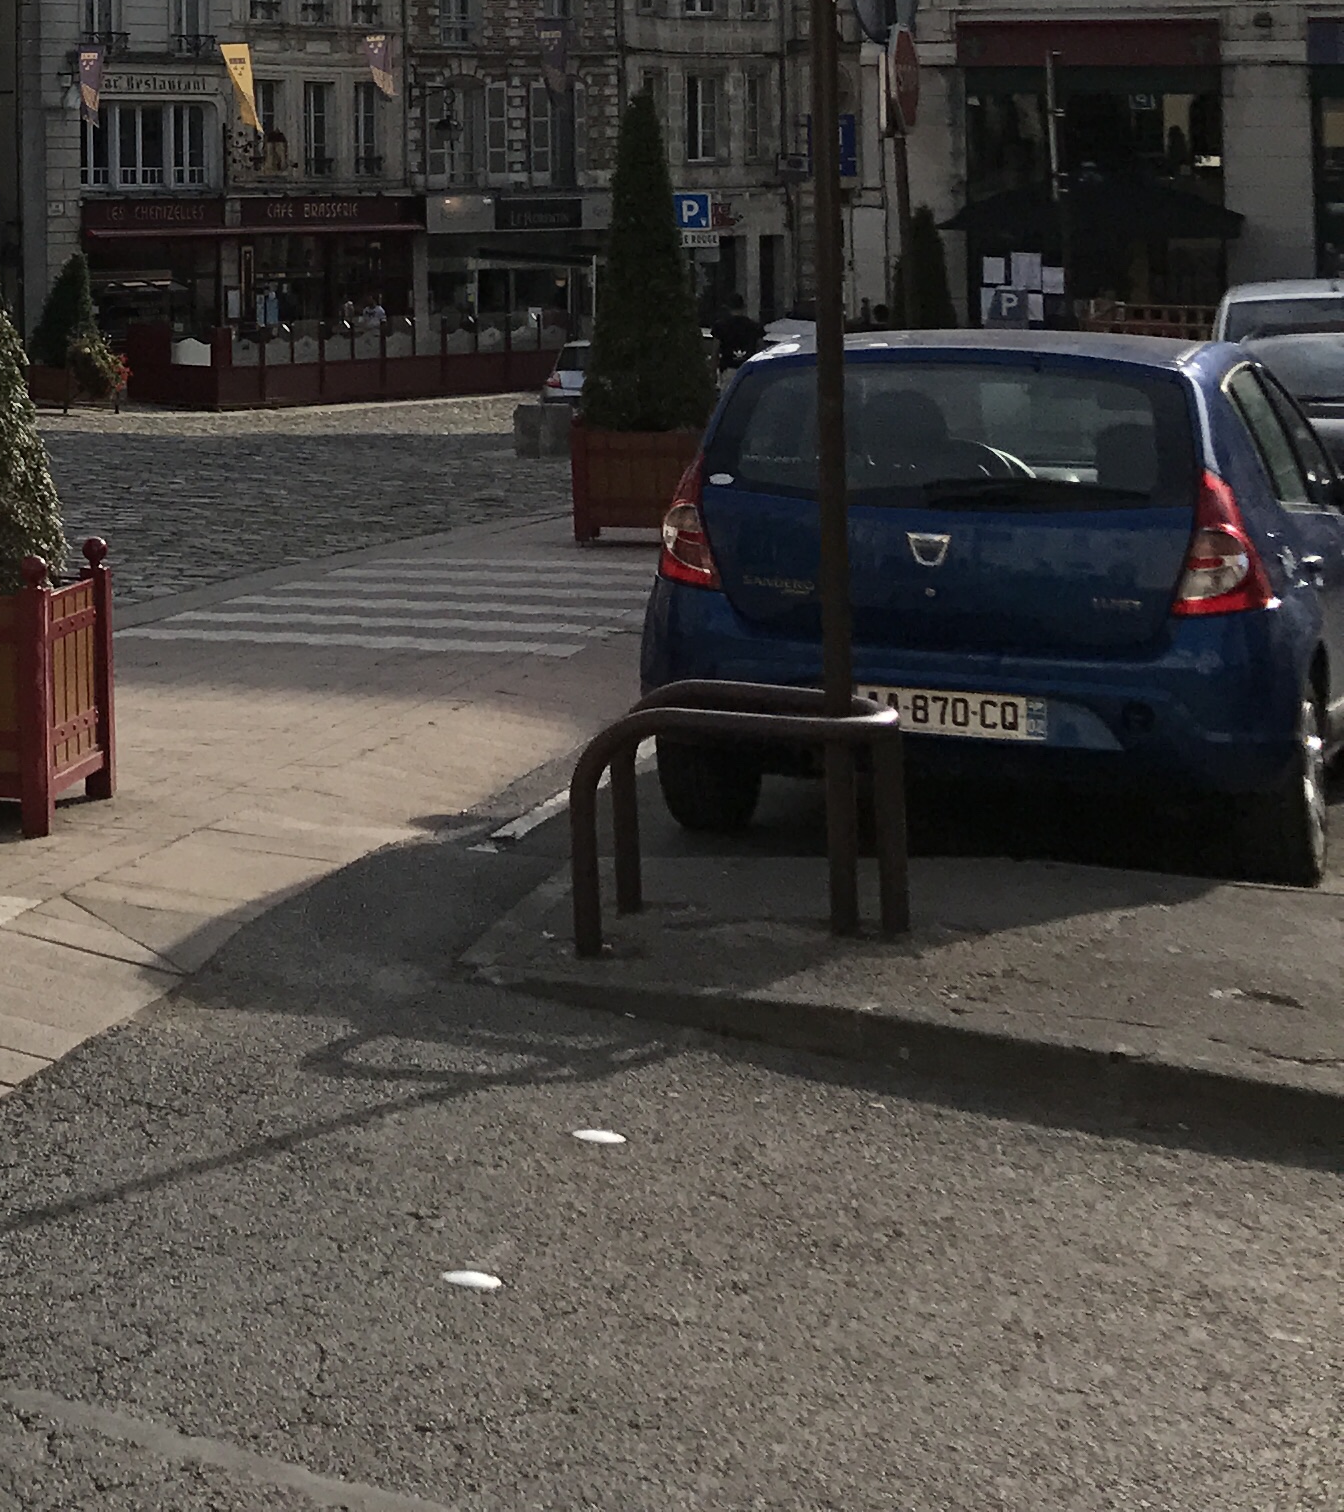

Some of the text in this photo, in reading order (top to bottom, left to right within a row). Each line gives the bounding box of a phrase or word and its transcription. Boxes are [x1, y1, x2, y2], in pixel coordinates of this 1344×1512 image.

[126, 75, 206, 91] Restaurant
[303, 202, 359, 219] BRASSERIE
[681, 199, 700, 224] P
[691, 234, 717, 245] ROUGE
[1000, 292, 1019, 317] P
[742, 574, 816, 592] SANDERO
